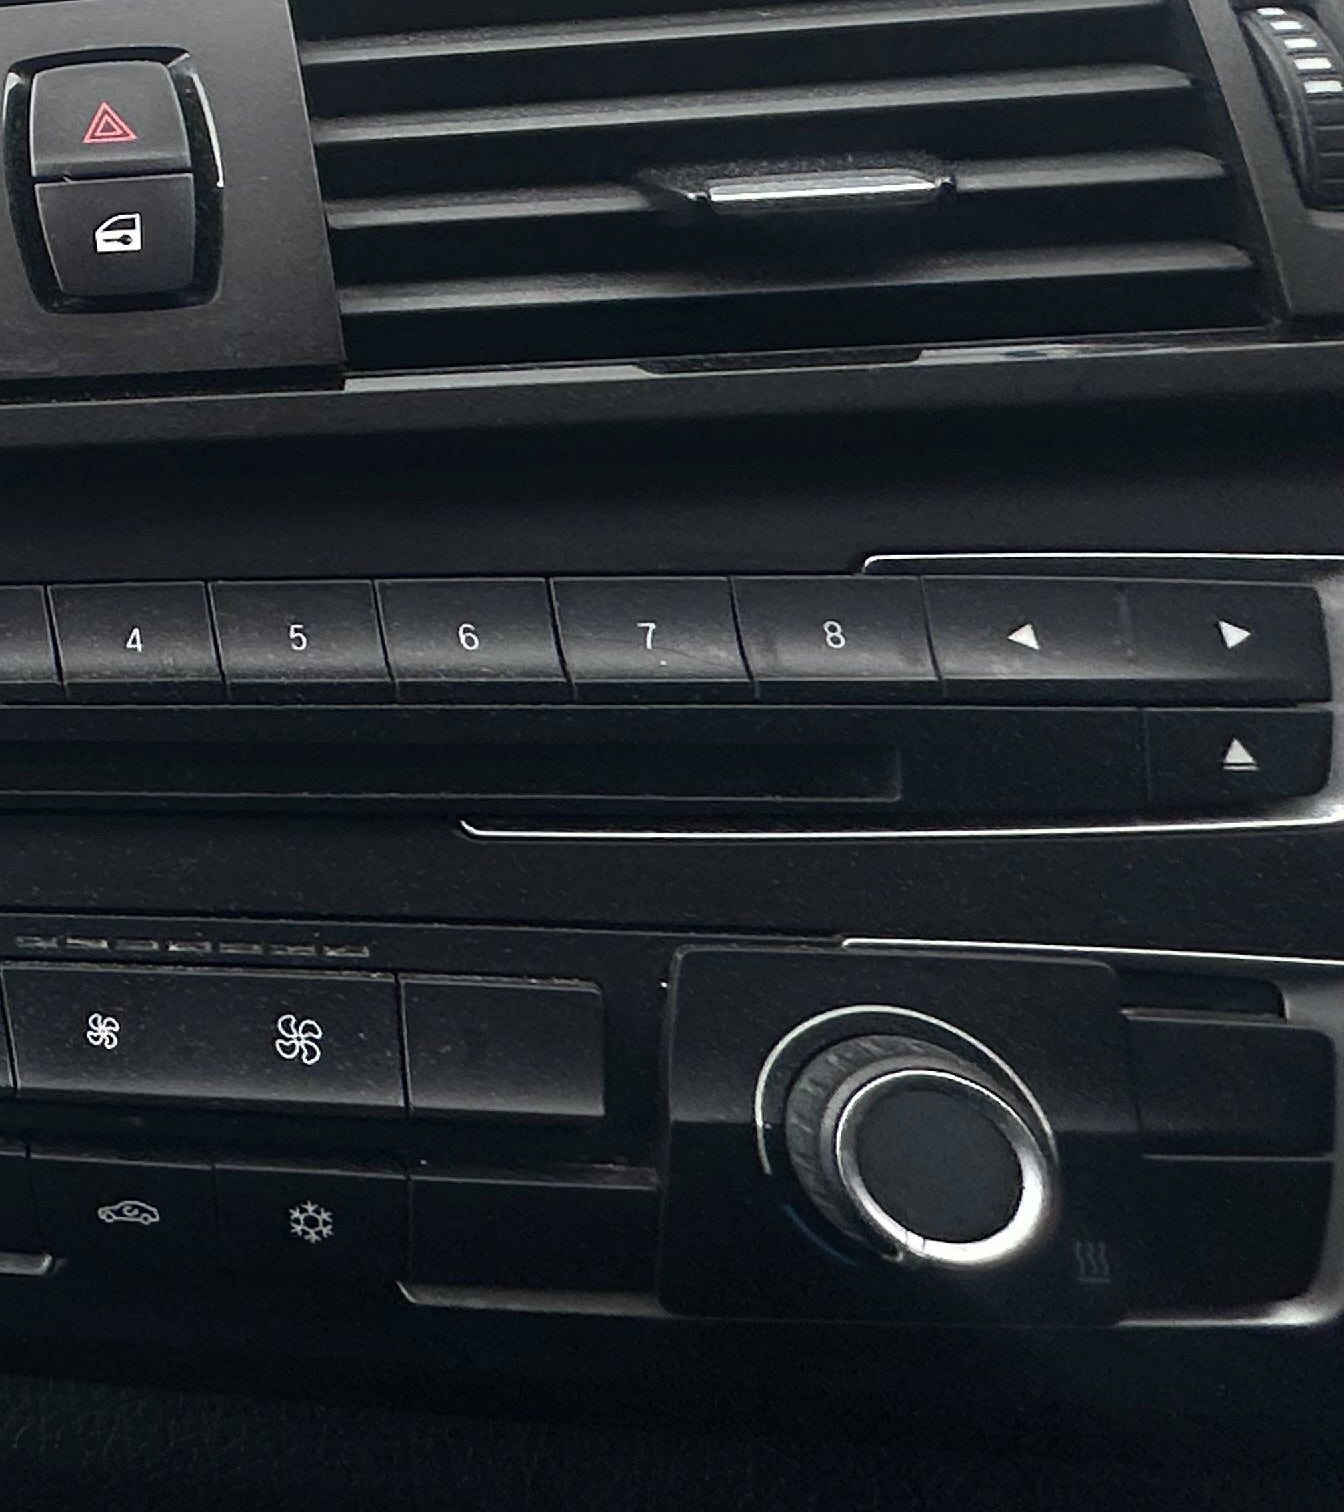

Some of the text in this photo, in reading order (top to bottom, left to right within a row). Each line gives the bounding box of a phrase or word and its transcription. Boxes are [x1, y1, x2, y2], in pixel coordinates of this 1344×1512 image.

[126, 627, 143, 653] 4
[289, 624, 307, 651] 5
[458, 623, 479, 651] 6
[637, 622, 656, 650] 7
[823, 620, 846, 649] 8
